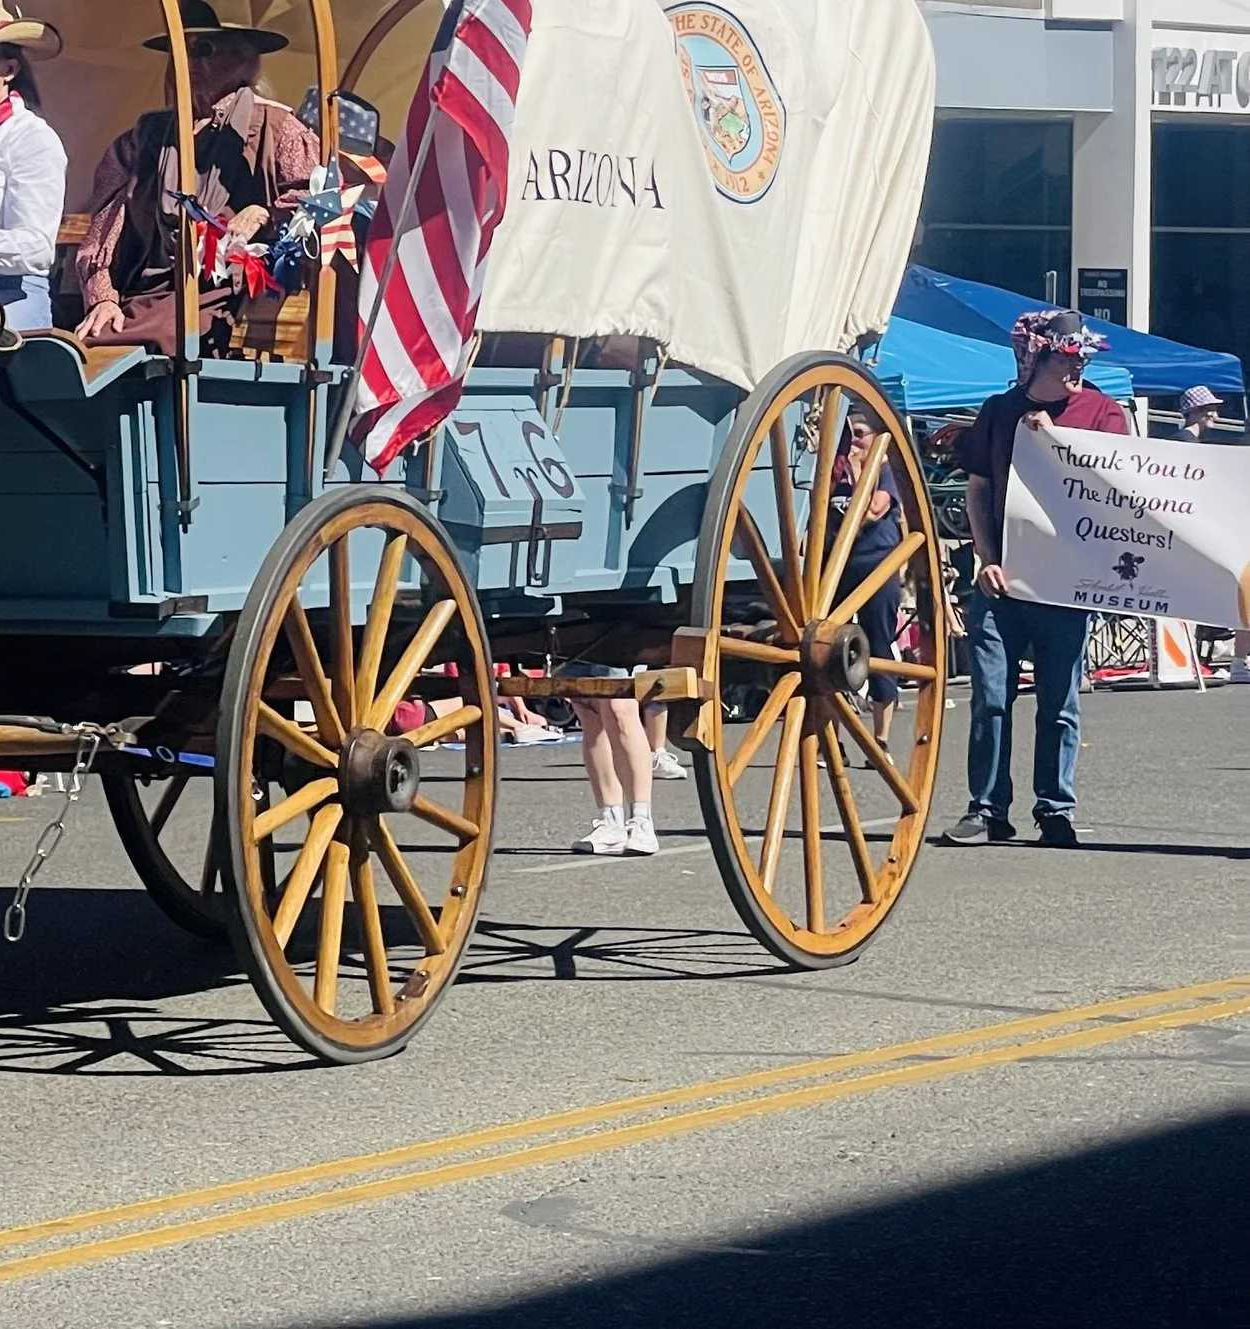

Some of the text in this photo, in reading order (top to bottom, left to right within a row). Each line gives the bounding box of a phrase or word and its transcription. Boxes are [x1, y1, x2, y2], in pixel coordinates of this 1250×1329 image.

[700, 15, 744, 55] STATE
[742, 54, 759, 78] OF
[753, 87, 780, 166] ARIZONA
[521, 149, 666, 210] ARIZONA
[1051, 444, 1206, 481] Thank You to
[1063, 477, 1195, 519] The Arizona
[1075, 516, 1174, 550] Questers!
[1073, 590, 1169, 614] MUSEUM
